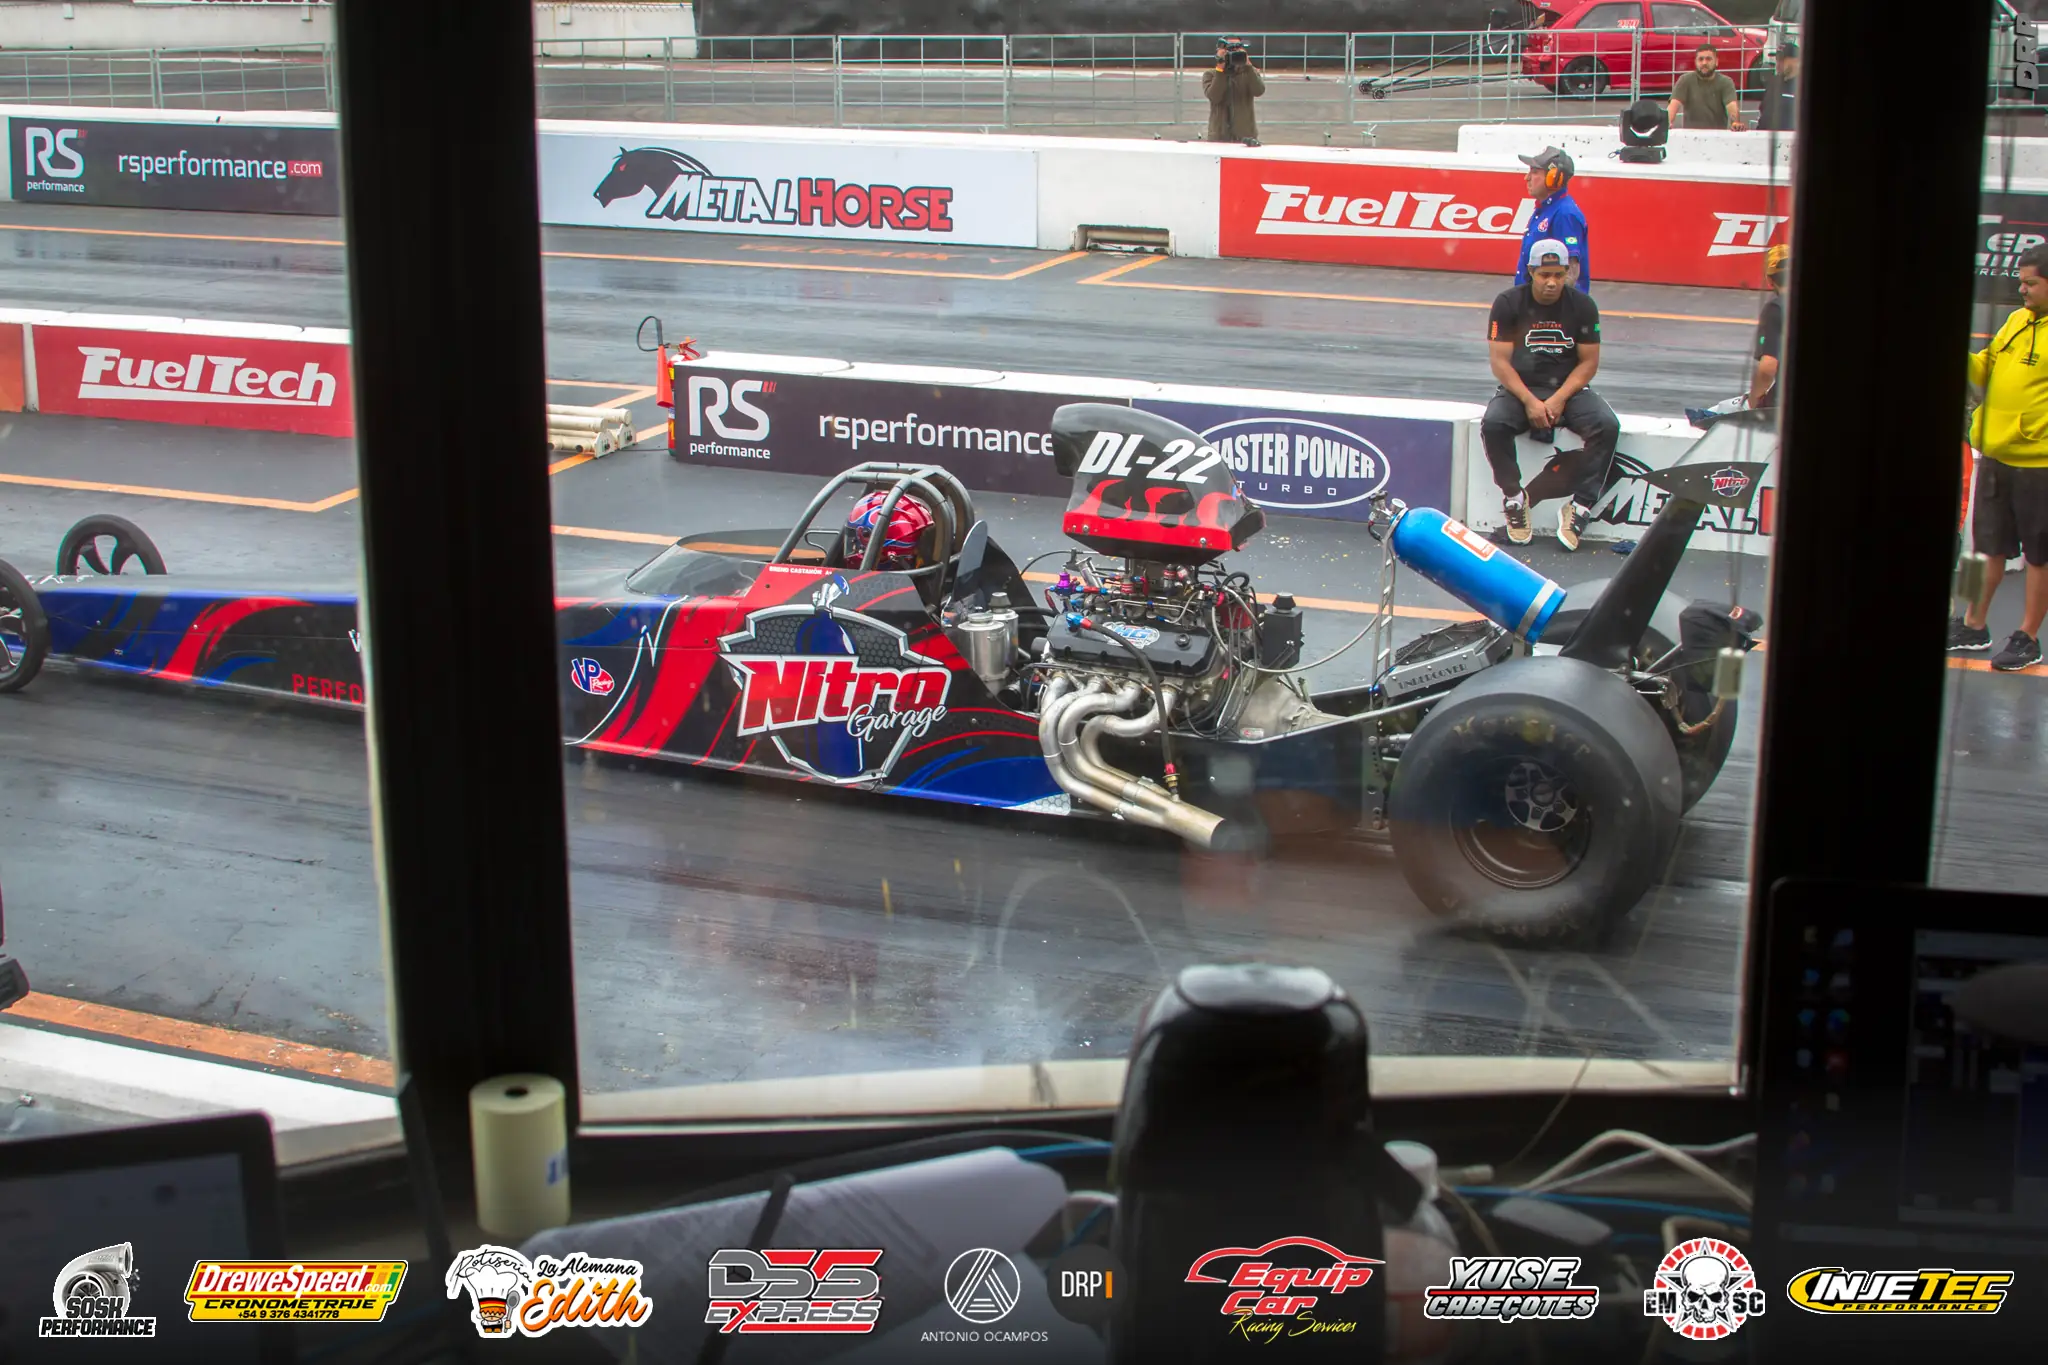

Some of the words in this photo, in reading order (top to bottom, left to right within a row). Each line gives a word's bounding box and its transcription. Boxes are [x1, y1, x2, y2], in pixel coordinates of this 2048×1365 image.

[25, 127, 84, 178] RS
[26, 180, 85, 193] performance
[78, 346, 336, 406] FuelTech
[688, 375, 770, 442] RS
[690, 442, 771, 460] performance
[1078, 431, 1222, 484] DL-22
[1294, 434, 1376, 479] POWER
[571, 657, 601, 693] VP
[846, 703, 948, 742] Garage
